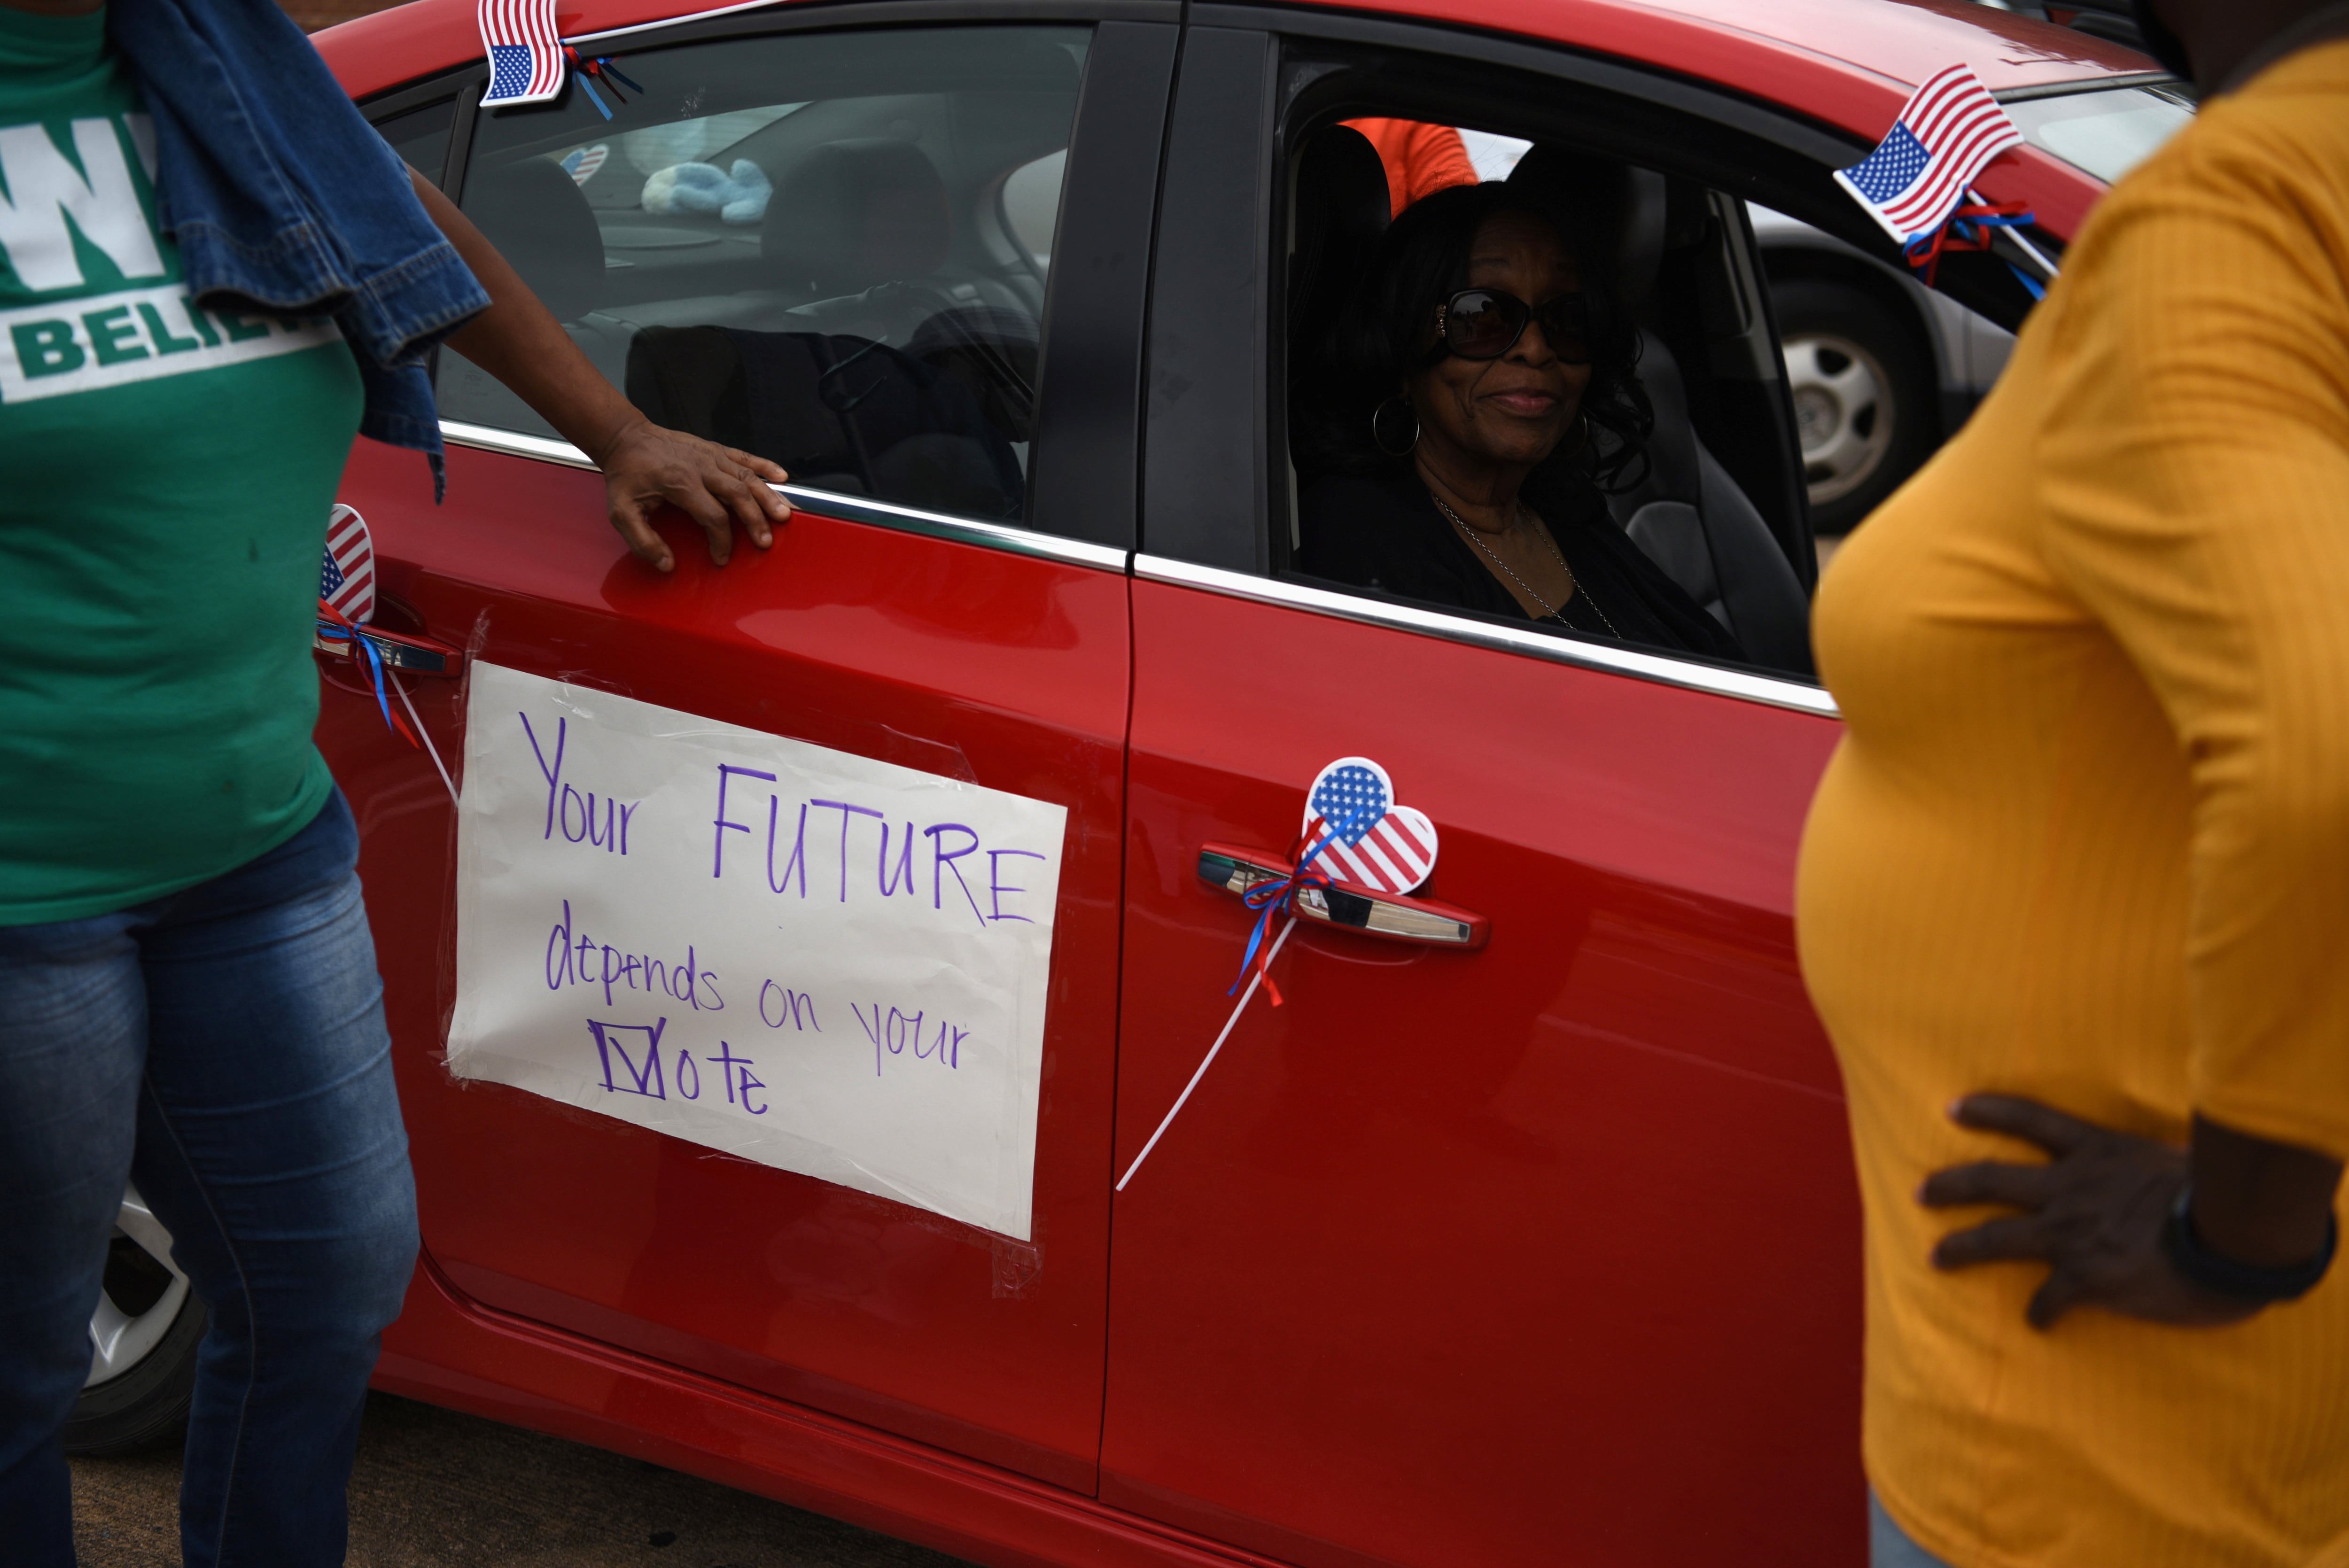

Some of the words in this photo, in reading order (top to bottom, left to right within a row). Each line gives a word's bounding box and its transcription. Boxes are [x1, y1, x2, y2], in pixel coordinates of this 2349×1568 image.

[520, 712, 640, 855] Your
[713, 764, 1046, 926] FUTURE
[546, 900, 725, 1010] depends
[759, 979, 820, 1032] on
[851, 1002, 970, 1076] your
